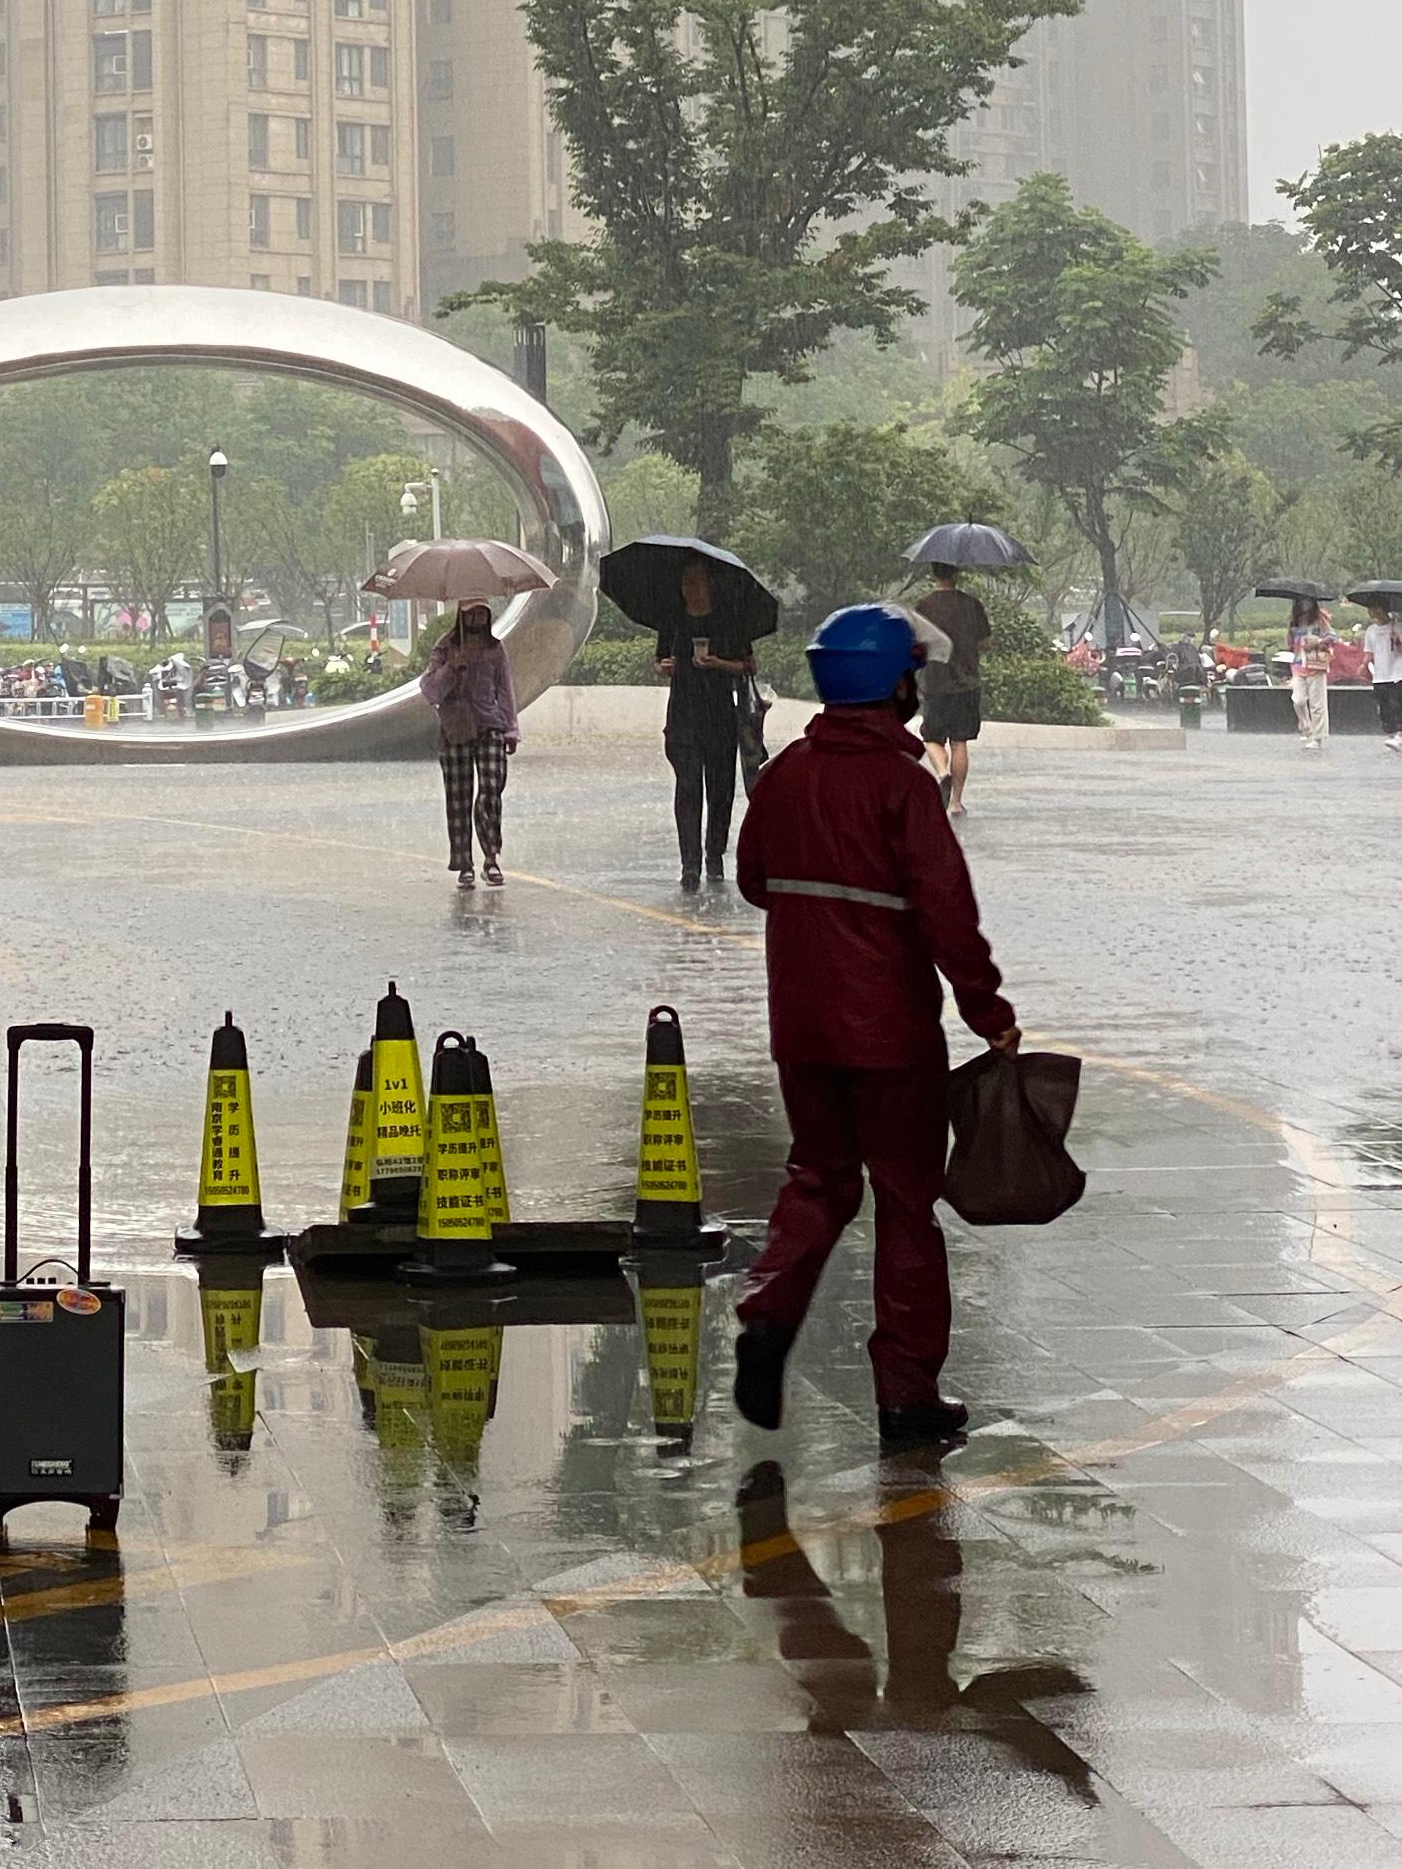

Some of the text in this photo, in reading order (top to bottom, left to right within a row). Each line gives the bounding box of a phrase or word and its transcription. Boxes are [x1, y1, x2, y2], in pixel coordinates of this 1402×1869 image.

[384, 1079, 408, 1090] 1v1
[380, 1101, 416, 1115] 小班化
[377, 1125, 421, 1139] 精品晚托
[438, 1143, 477, 1154] 学历提升
[438, 1169, 479, 1181] 职称评审
[437, 1195, 484, 1209] 技能证书
